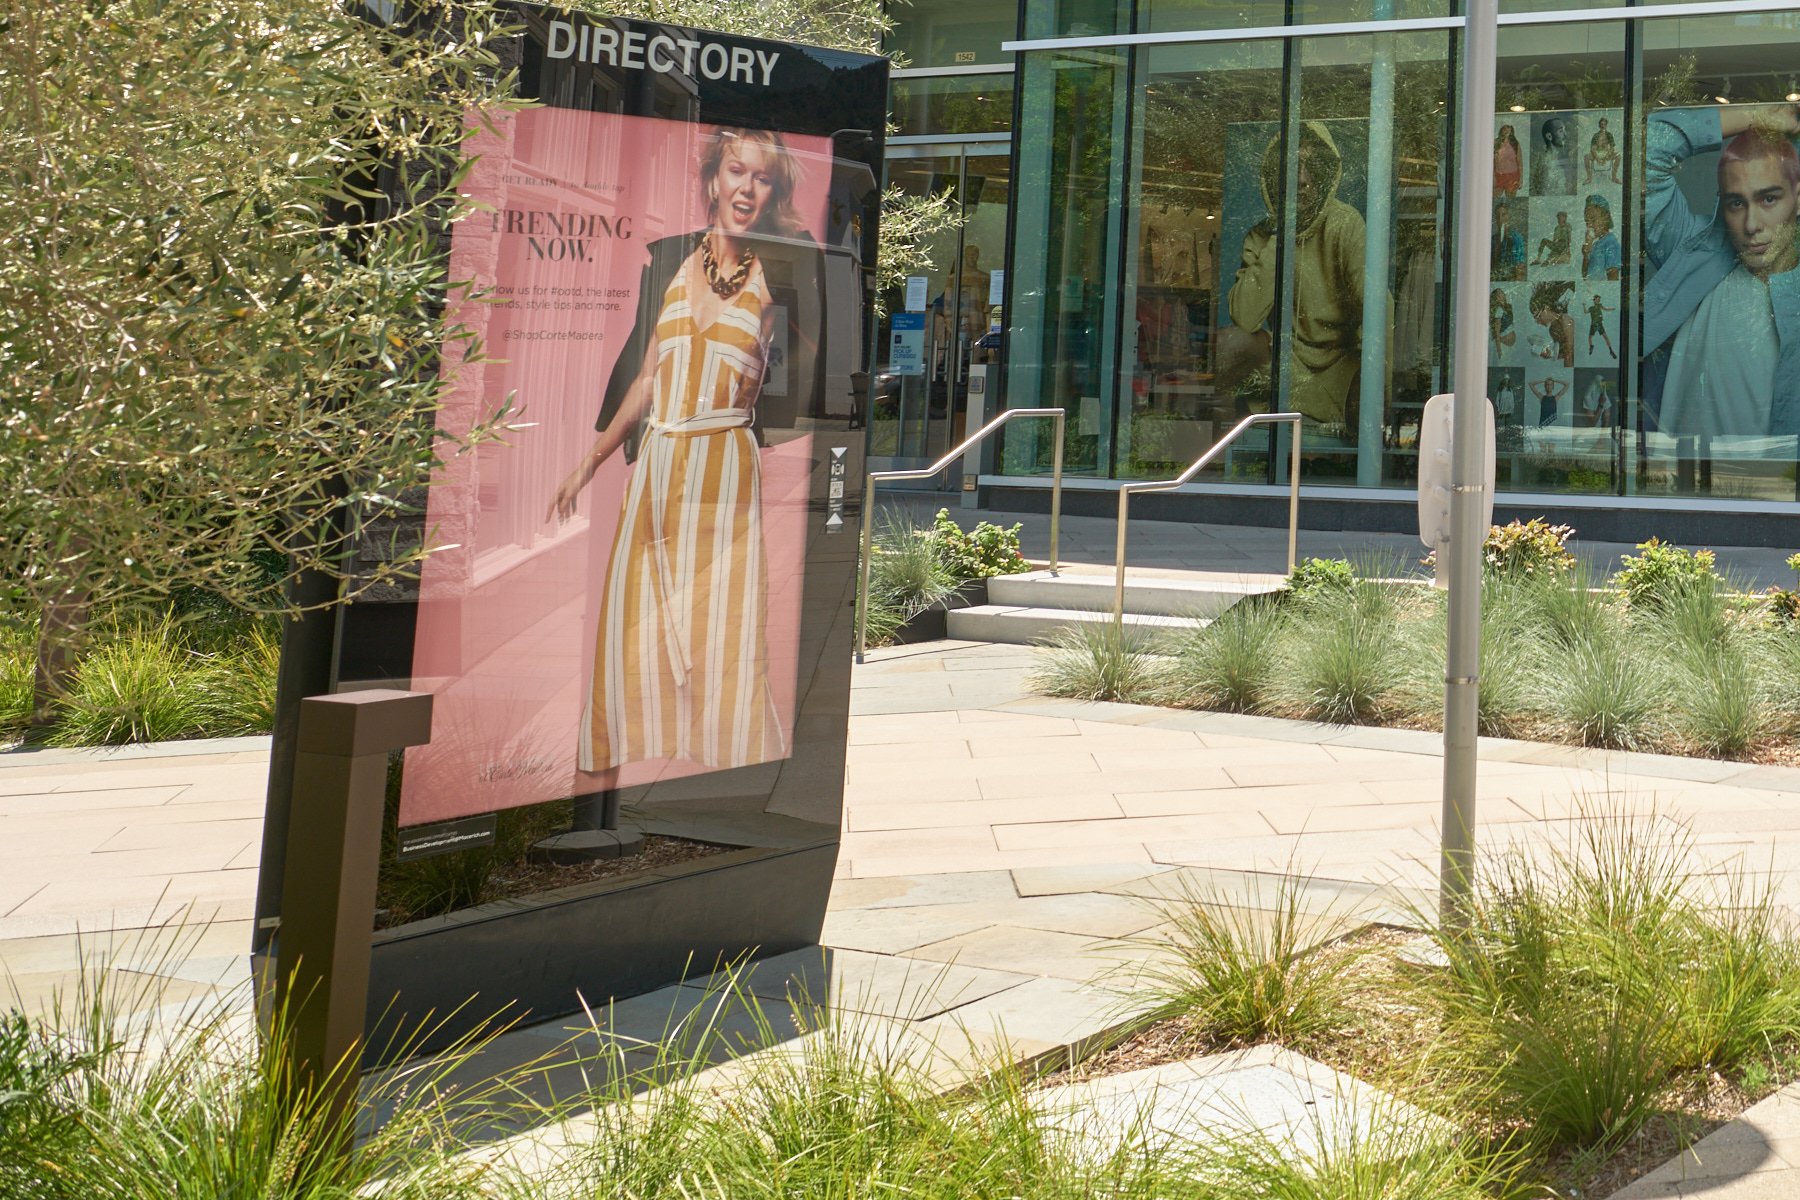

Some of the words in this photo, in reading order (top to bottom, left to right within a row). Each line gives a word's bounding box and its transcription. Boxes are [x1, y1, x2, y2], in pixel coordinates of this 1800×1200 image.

[547, 20, 780, 86] DIRECTORY
[485, 208, 632, 240] TRENDING
[526, 237, 593, 262] NOW.
[478, 284, 514, 296] Flow
[518, 286, 529, 296] us
[533, 285, 547, 296] for
[587, 287, 601, 297] the
[604, 288, 631, 298] latest
[526, 300, 550, 311] style
[554, 302, 571, 312] tips
[575, 302, 593, 311] and
[596, 303, 622, 312] more.
[503, 329, 604, 342] @ShopCorteMadera
